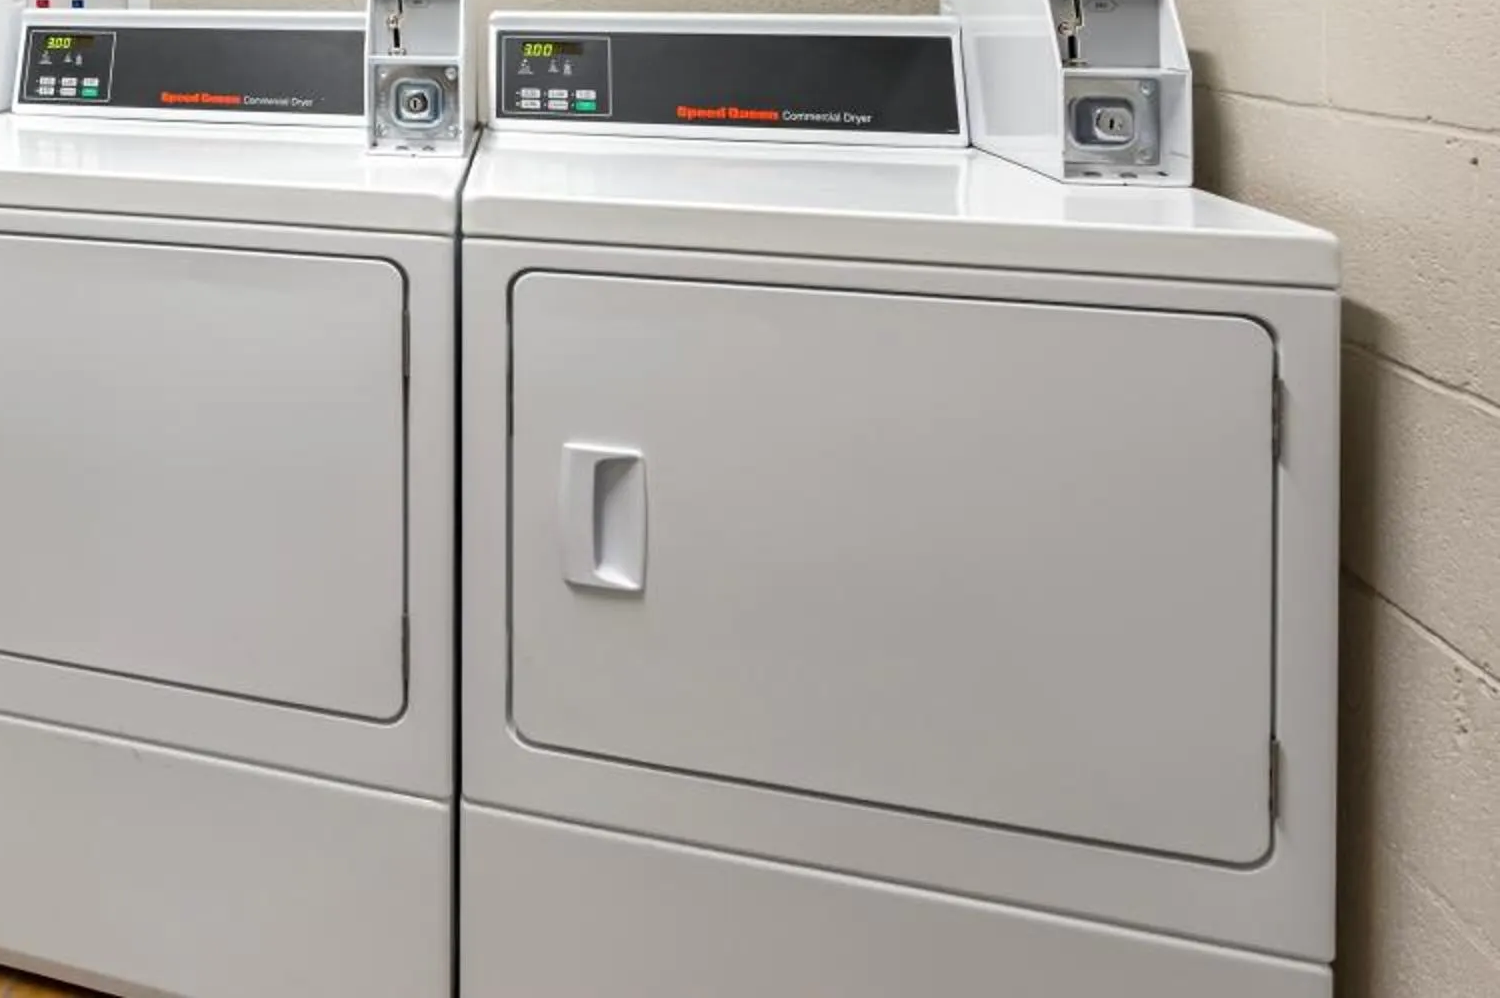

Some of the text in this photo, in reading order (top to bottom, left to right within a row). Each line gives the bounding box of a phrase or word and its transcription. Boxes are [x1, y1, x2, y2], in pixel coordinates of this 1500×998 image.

[291, 97, 313, 108] Dryer
[676, 105, 873, 126] Speed Queen Commercial Dryer
